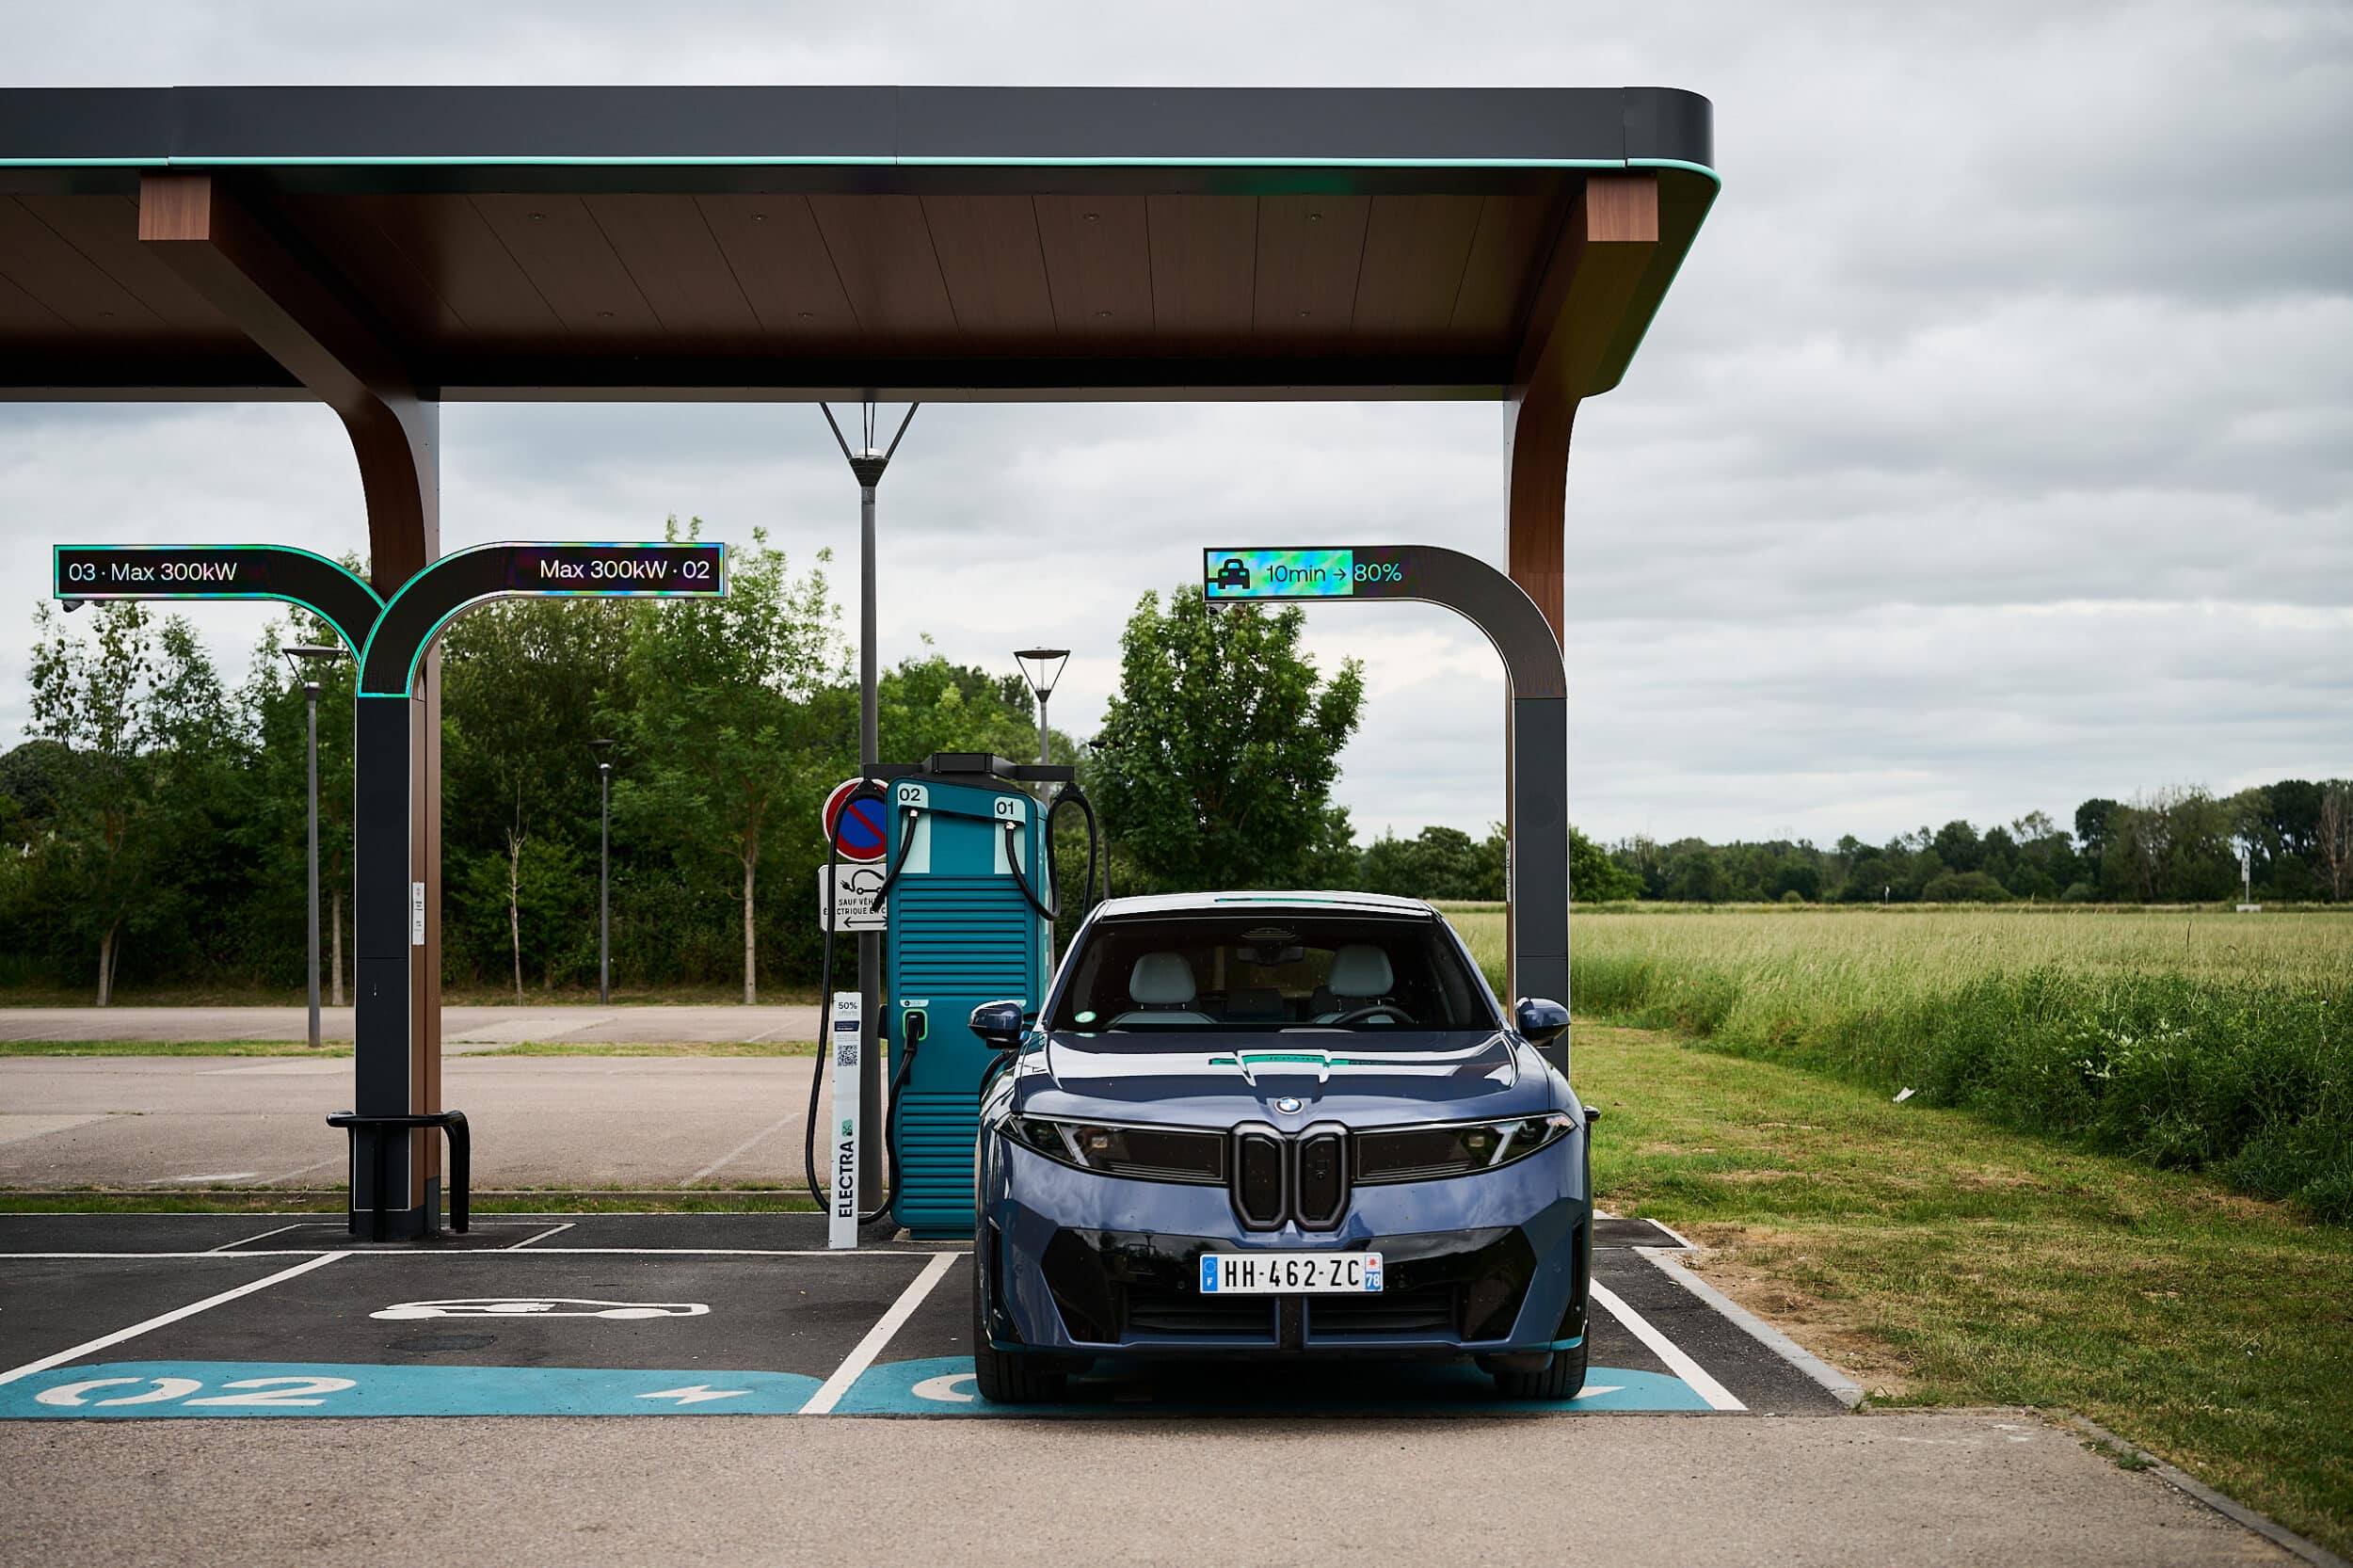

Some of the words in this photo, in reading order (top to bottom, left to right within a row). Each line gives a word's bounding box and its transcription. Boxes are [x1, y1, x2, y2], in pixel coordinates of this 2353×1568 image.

[69, 563, 96, 582] 03
[111, 563, 154, 582] Max
[160, 562, 237, 582] 300kW
[540, 559, 584, 579] Max
[590, 559, 667, 580] 300kW
[682, 560, 711, 580] 02
[1266, 564, 1326, 583] 10min
[1354, 563, 1402, 583] 80%
[899, 787, 921, 802] 02
[996, 801, 1015, 815] 01
[823, 906, 868, 916] ÉCTRIQUE
[838, 898, 857, 906] SAUF
[838, 1001, 858, 1010] 50%
[839, 1141, 855, 1218] ELECTRA
[1207, 1276, 1214, 1287] F
[1225, 1259, 1360, 1288] HH-462-ZC
[1366, 1273, 1381, 1287] 78
[35, 1376, 357, 1406] 02
